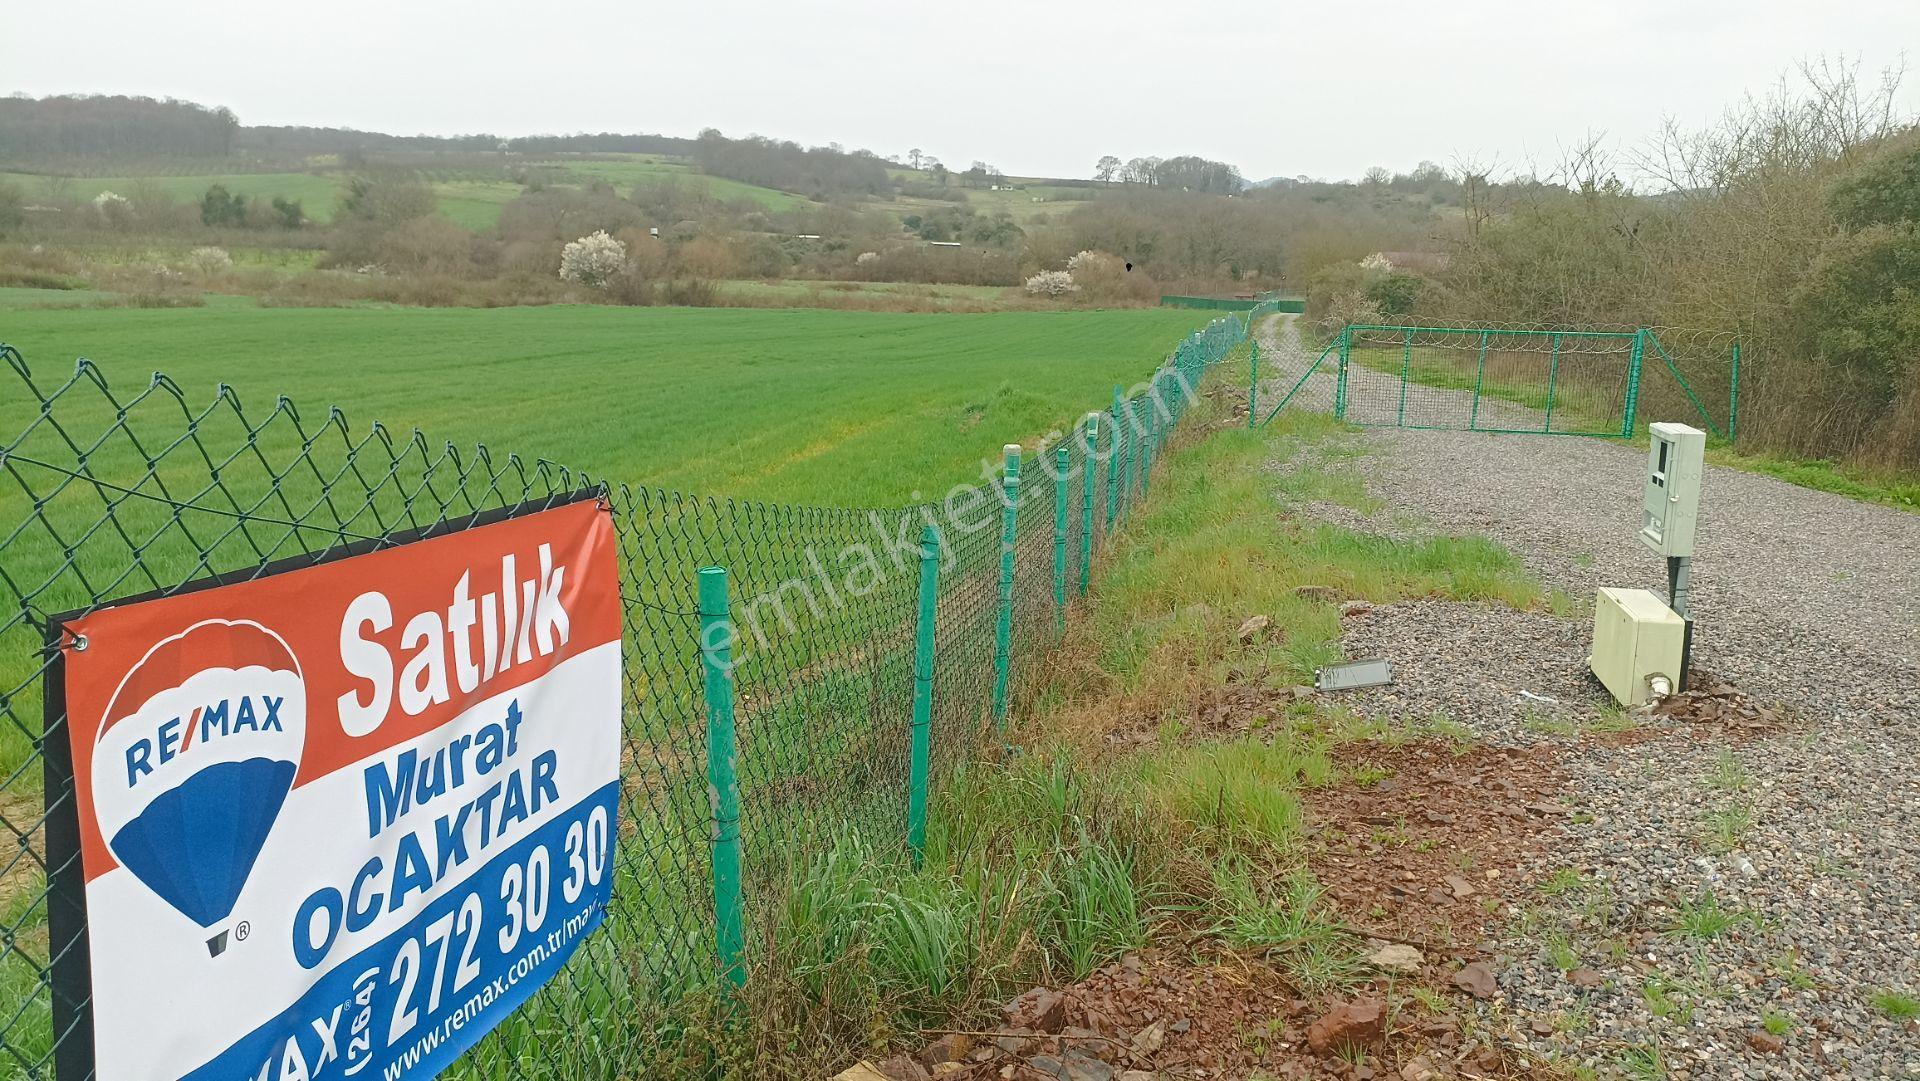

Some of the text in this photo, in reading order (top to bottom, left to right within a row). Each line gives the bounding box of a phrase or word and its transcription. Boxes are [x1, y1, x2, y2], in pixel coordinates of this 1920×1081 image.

[337, 542, 570, 738] Satılık
[125, 695, 283, 788] RE/MAX
[364, 697, 523, 842] Murat
[292, 749, 560, 970] OCAKTAR
[344, 805, 608, 1076] (264) 272 30 30
